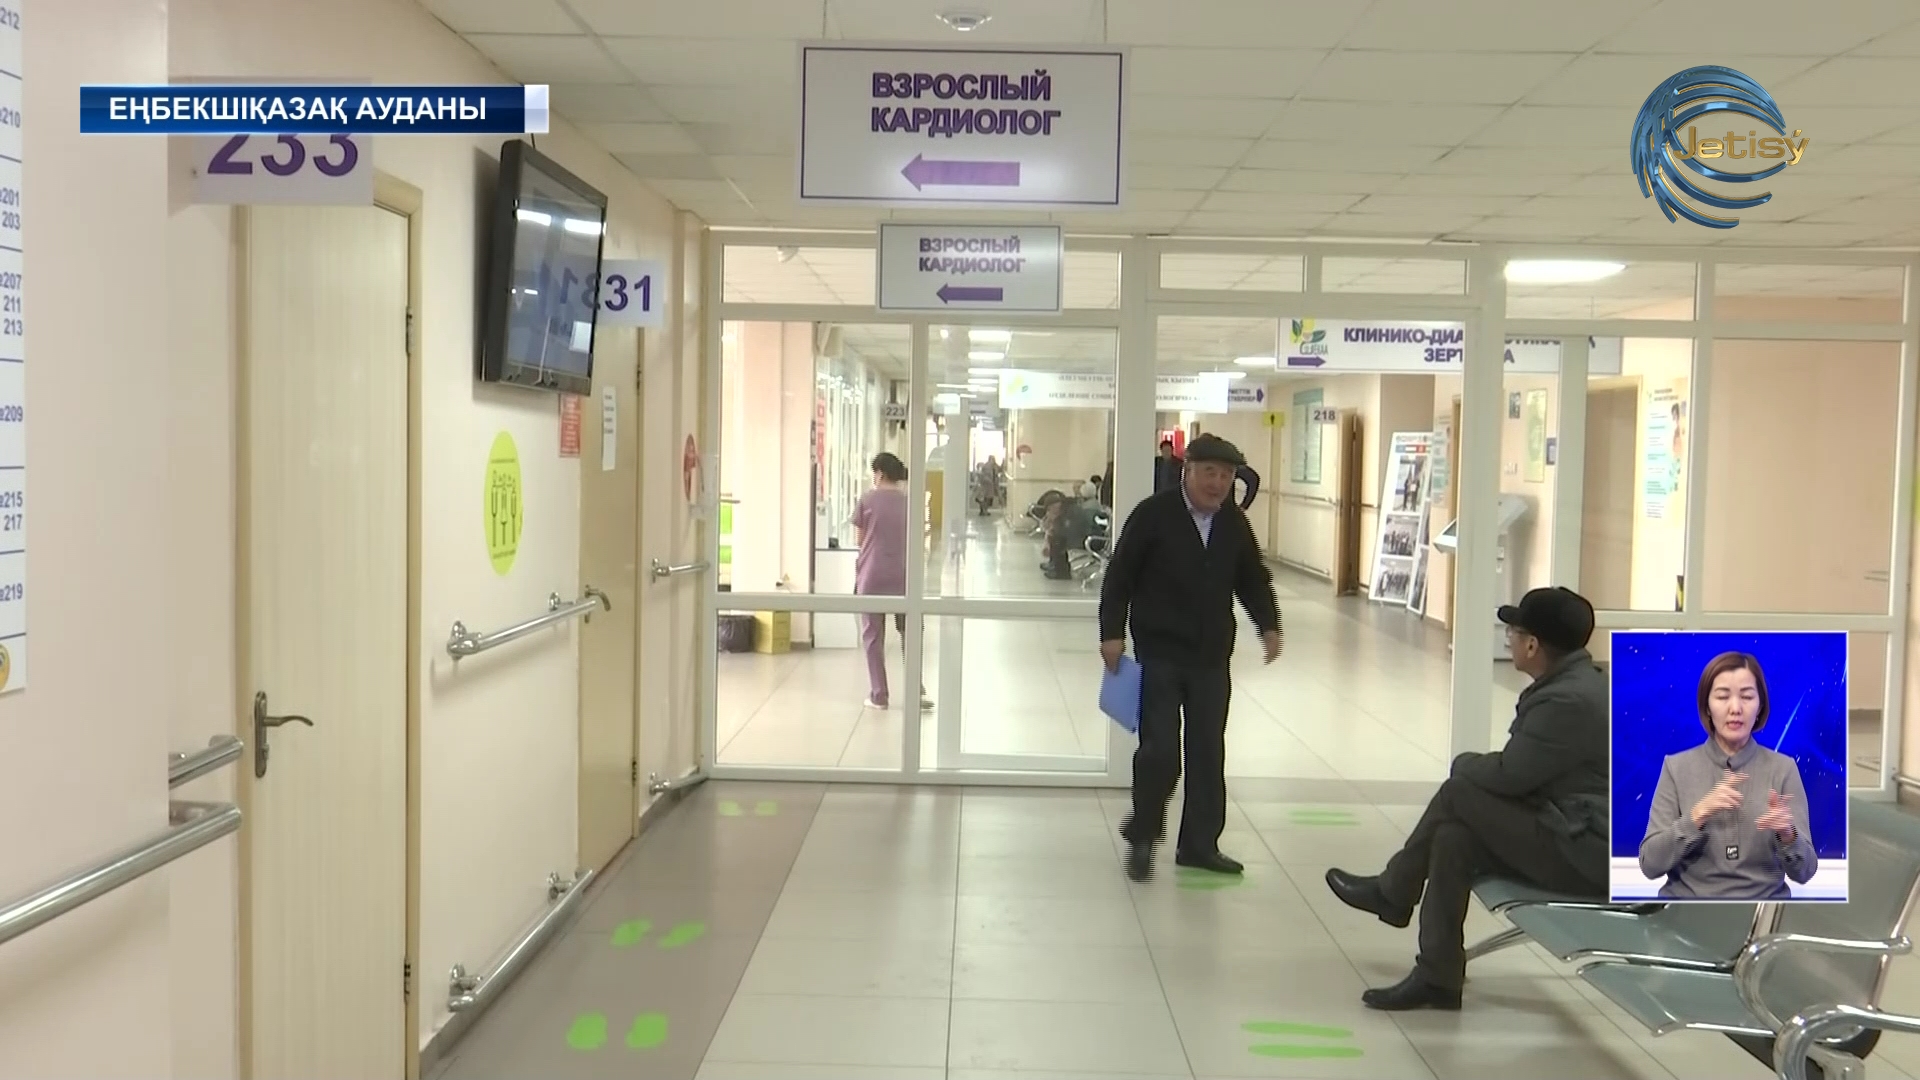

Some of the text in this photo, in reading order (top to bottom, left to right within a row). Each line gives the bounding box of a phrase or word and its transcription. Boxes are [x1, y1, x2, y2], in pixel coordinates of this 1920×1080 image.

[872, 69, 1052, 102] ВЗРОСЛЫЙ
[871, 106, 1062, 138] КАРДИОЛОГ
[2, 210, 21, 231] 203
[918, 234, 1021, 254] ВЗРОСЛЫЙ
[918, 256, 1026, 275] КАРДИОЛОГ
[604, 274, 651, 312] 31
[4, 294, 21, 313] 211
[4, 318, 23, 337] 213
[1313, 410, 1336, 421] 218
[4, 514, 22, 532] 217
